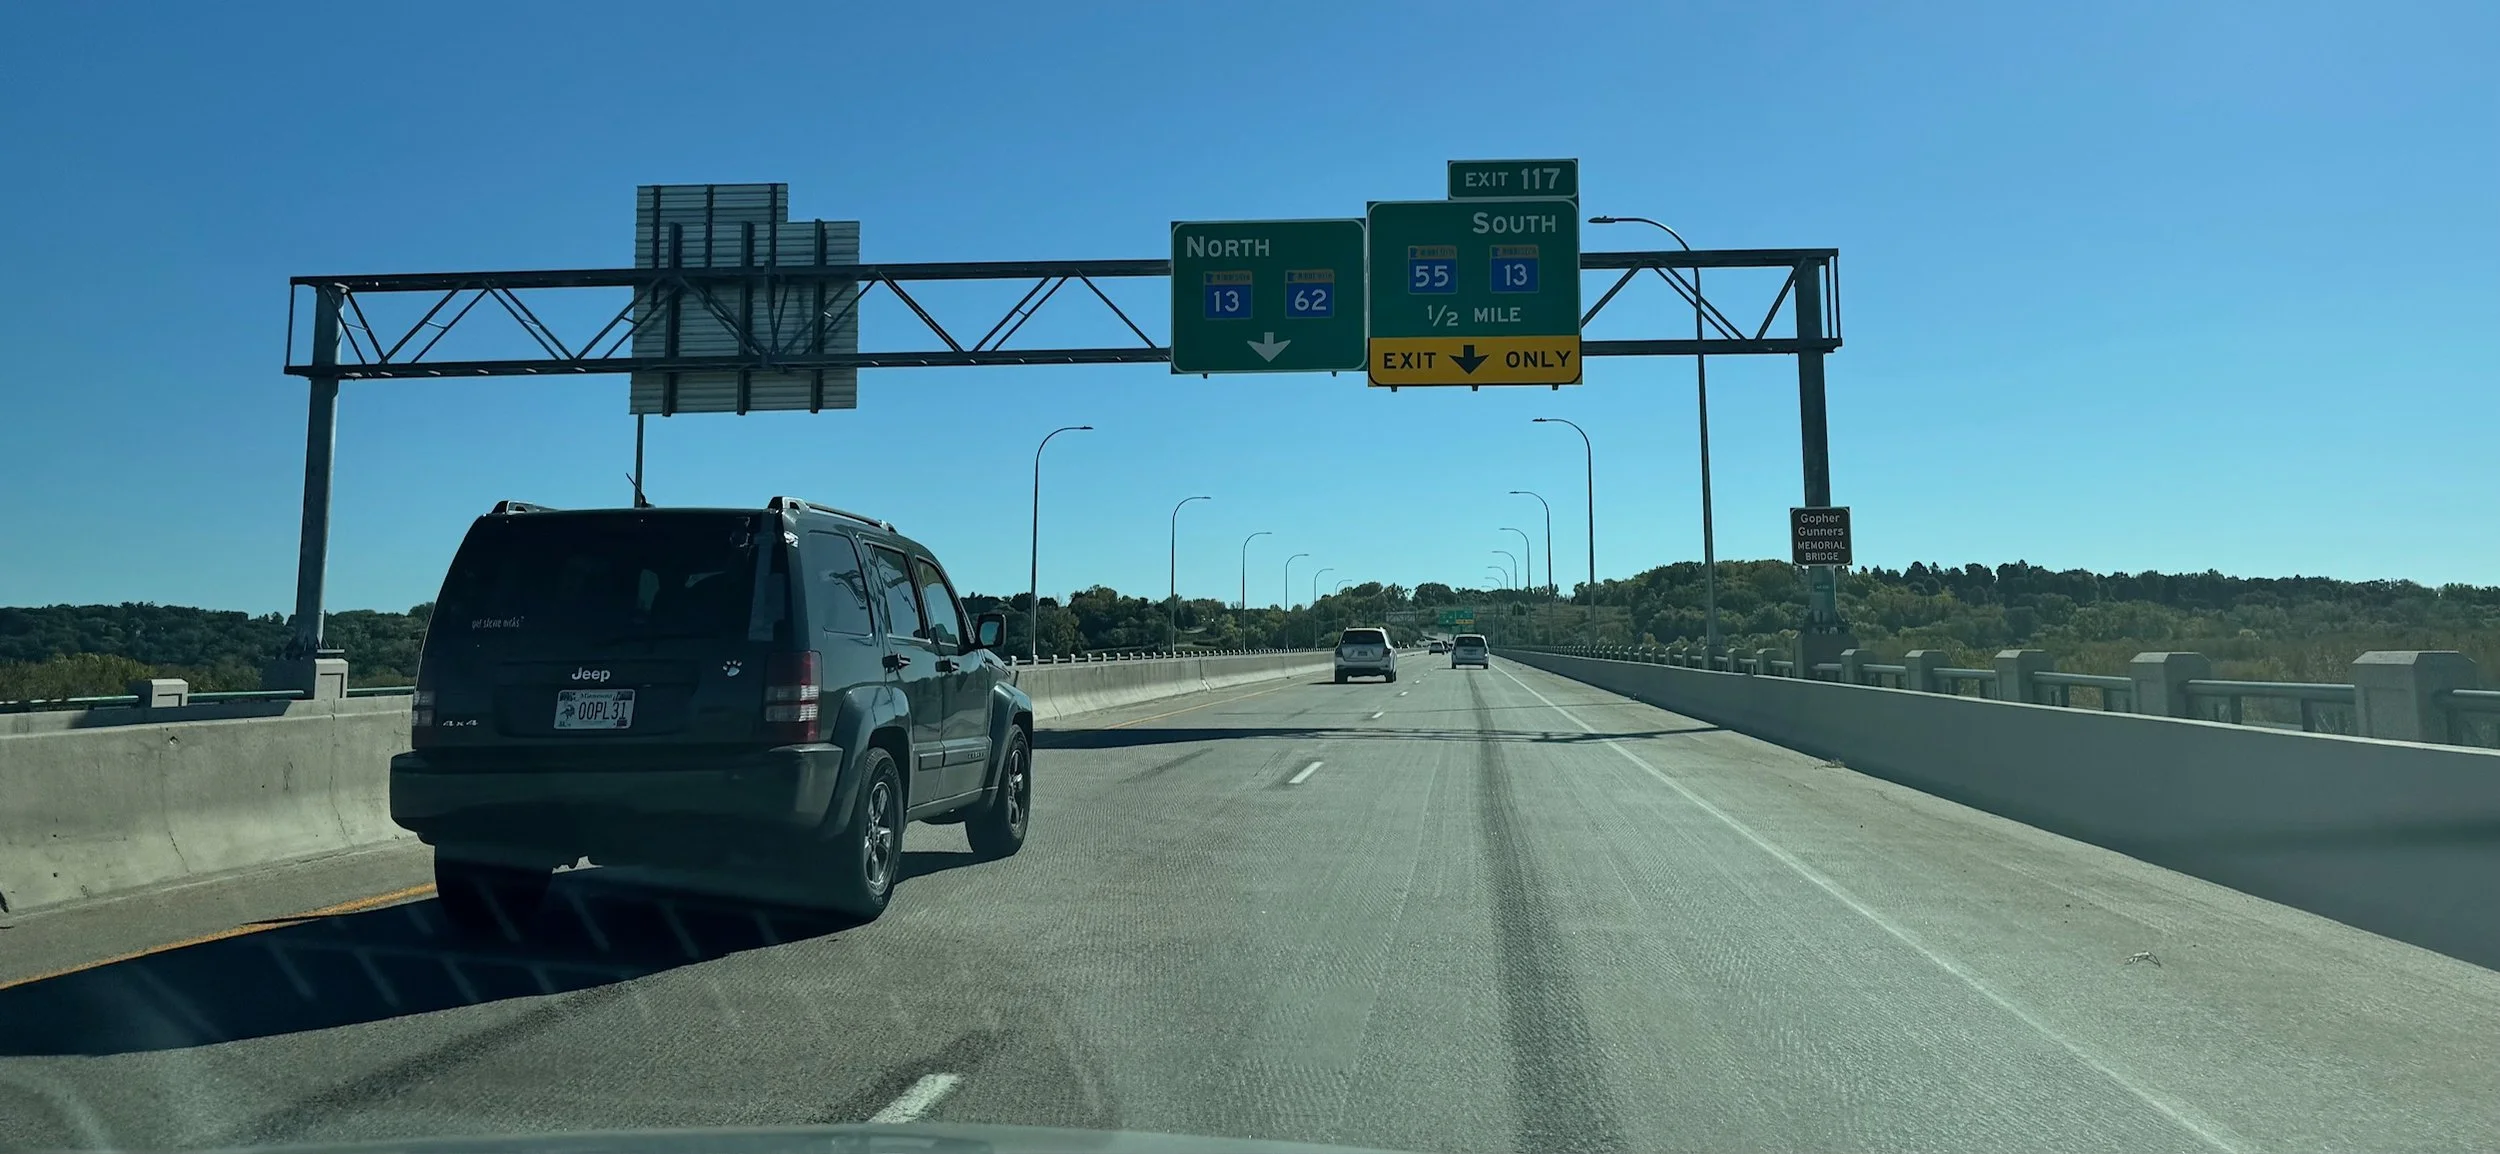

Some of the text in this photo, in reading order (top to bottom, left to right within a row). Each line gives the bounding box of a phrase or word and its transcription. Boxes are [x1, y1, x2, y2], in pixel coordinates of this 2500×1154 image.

[1465, 168, 1561, 190] EXIT 117
[1472, 212, 1557, 234] SOUTH
[1186, 236, 1270, 258] NORTH
[1415, 264, 1449, 288] 55
[1504, 263, 1528, 286] 13
[1213, 290, 1240, 313] 13
[1294, 288, 1327, 311] 62
[1427, 304, 1521, 327] 1/2 MILE
[1383, 350, 1571, 369] EXIT ONLY
[1800, 513, 1840, 525] Gopher
[1798, 526, 1844, 536] Gunners
[1797, 540, 1846, 550] MEMORIAL
[1805, 552, 1839, 561] BRIDGE
[571, 666, 611, 683] Jeep
